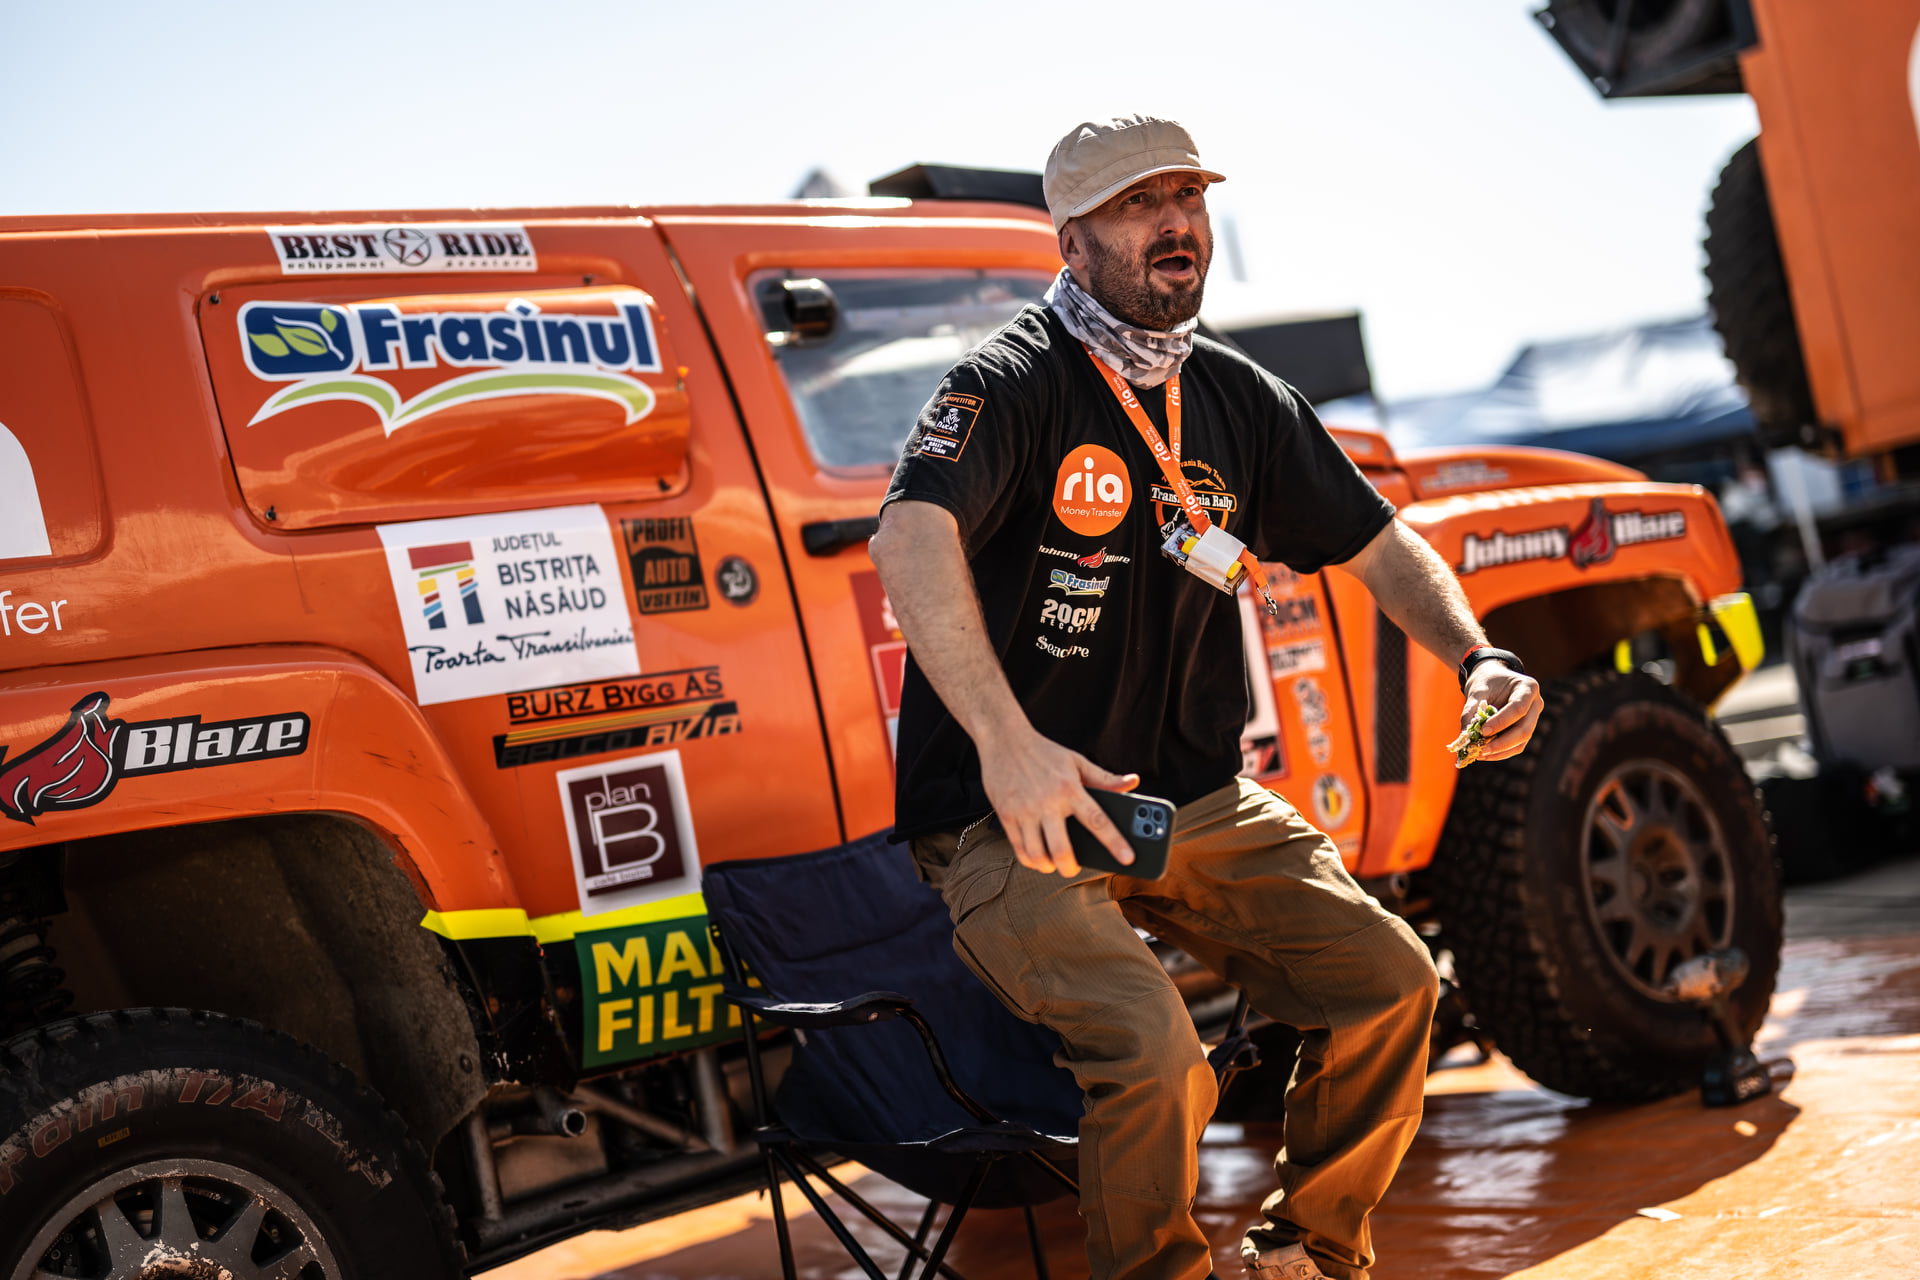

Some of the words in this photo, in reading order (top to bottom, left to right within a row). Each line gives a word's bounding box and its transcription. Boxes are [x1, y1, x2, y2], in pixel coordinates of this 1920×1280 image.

[278, 233, 378, 260] BEST
[437, 231, 531, 258] RIDE
[356, 303, 657, 368] Frasinul
[1121, 388, 1139, 409] ria
[1154, 441, 1171, 462] ria
[1063, 456, 1124, 504] ria
[1060, 505, 1091, 518] Money
[1091, 507, 1122, 518] Transfer
[1185, 494, 1202, 515] ria
[1212, 494, 1233, 512] Rally
[631, 517, 686, 544] PROFI
[496, 553, 601, 586] BISTRIȚA
[643, 556, 692, 585] AUTO
[1067, 573, 1111, 590] Frasinul
[0, 590, 69, 637] fer
[504, 585, 607, 620] NĂSĂUD
[1041, 598, 1102, 628] 20CM
[408, 639, 507, 674] Poarta
[506, 686, 595, 719] BURZ
[602, 682, 676, 710] BYGG
[684, 670, 724, 697] AS
[123, 717, 306, 772] Blaze
[584, 773, 652, 846] plan
[593, 802, 666, 874] B
[597, 982, 762, 1053] FILT
